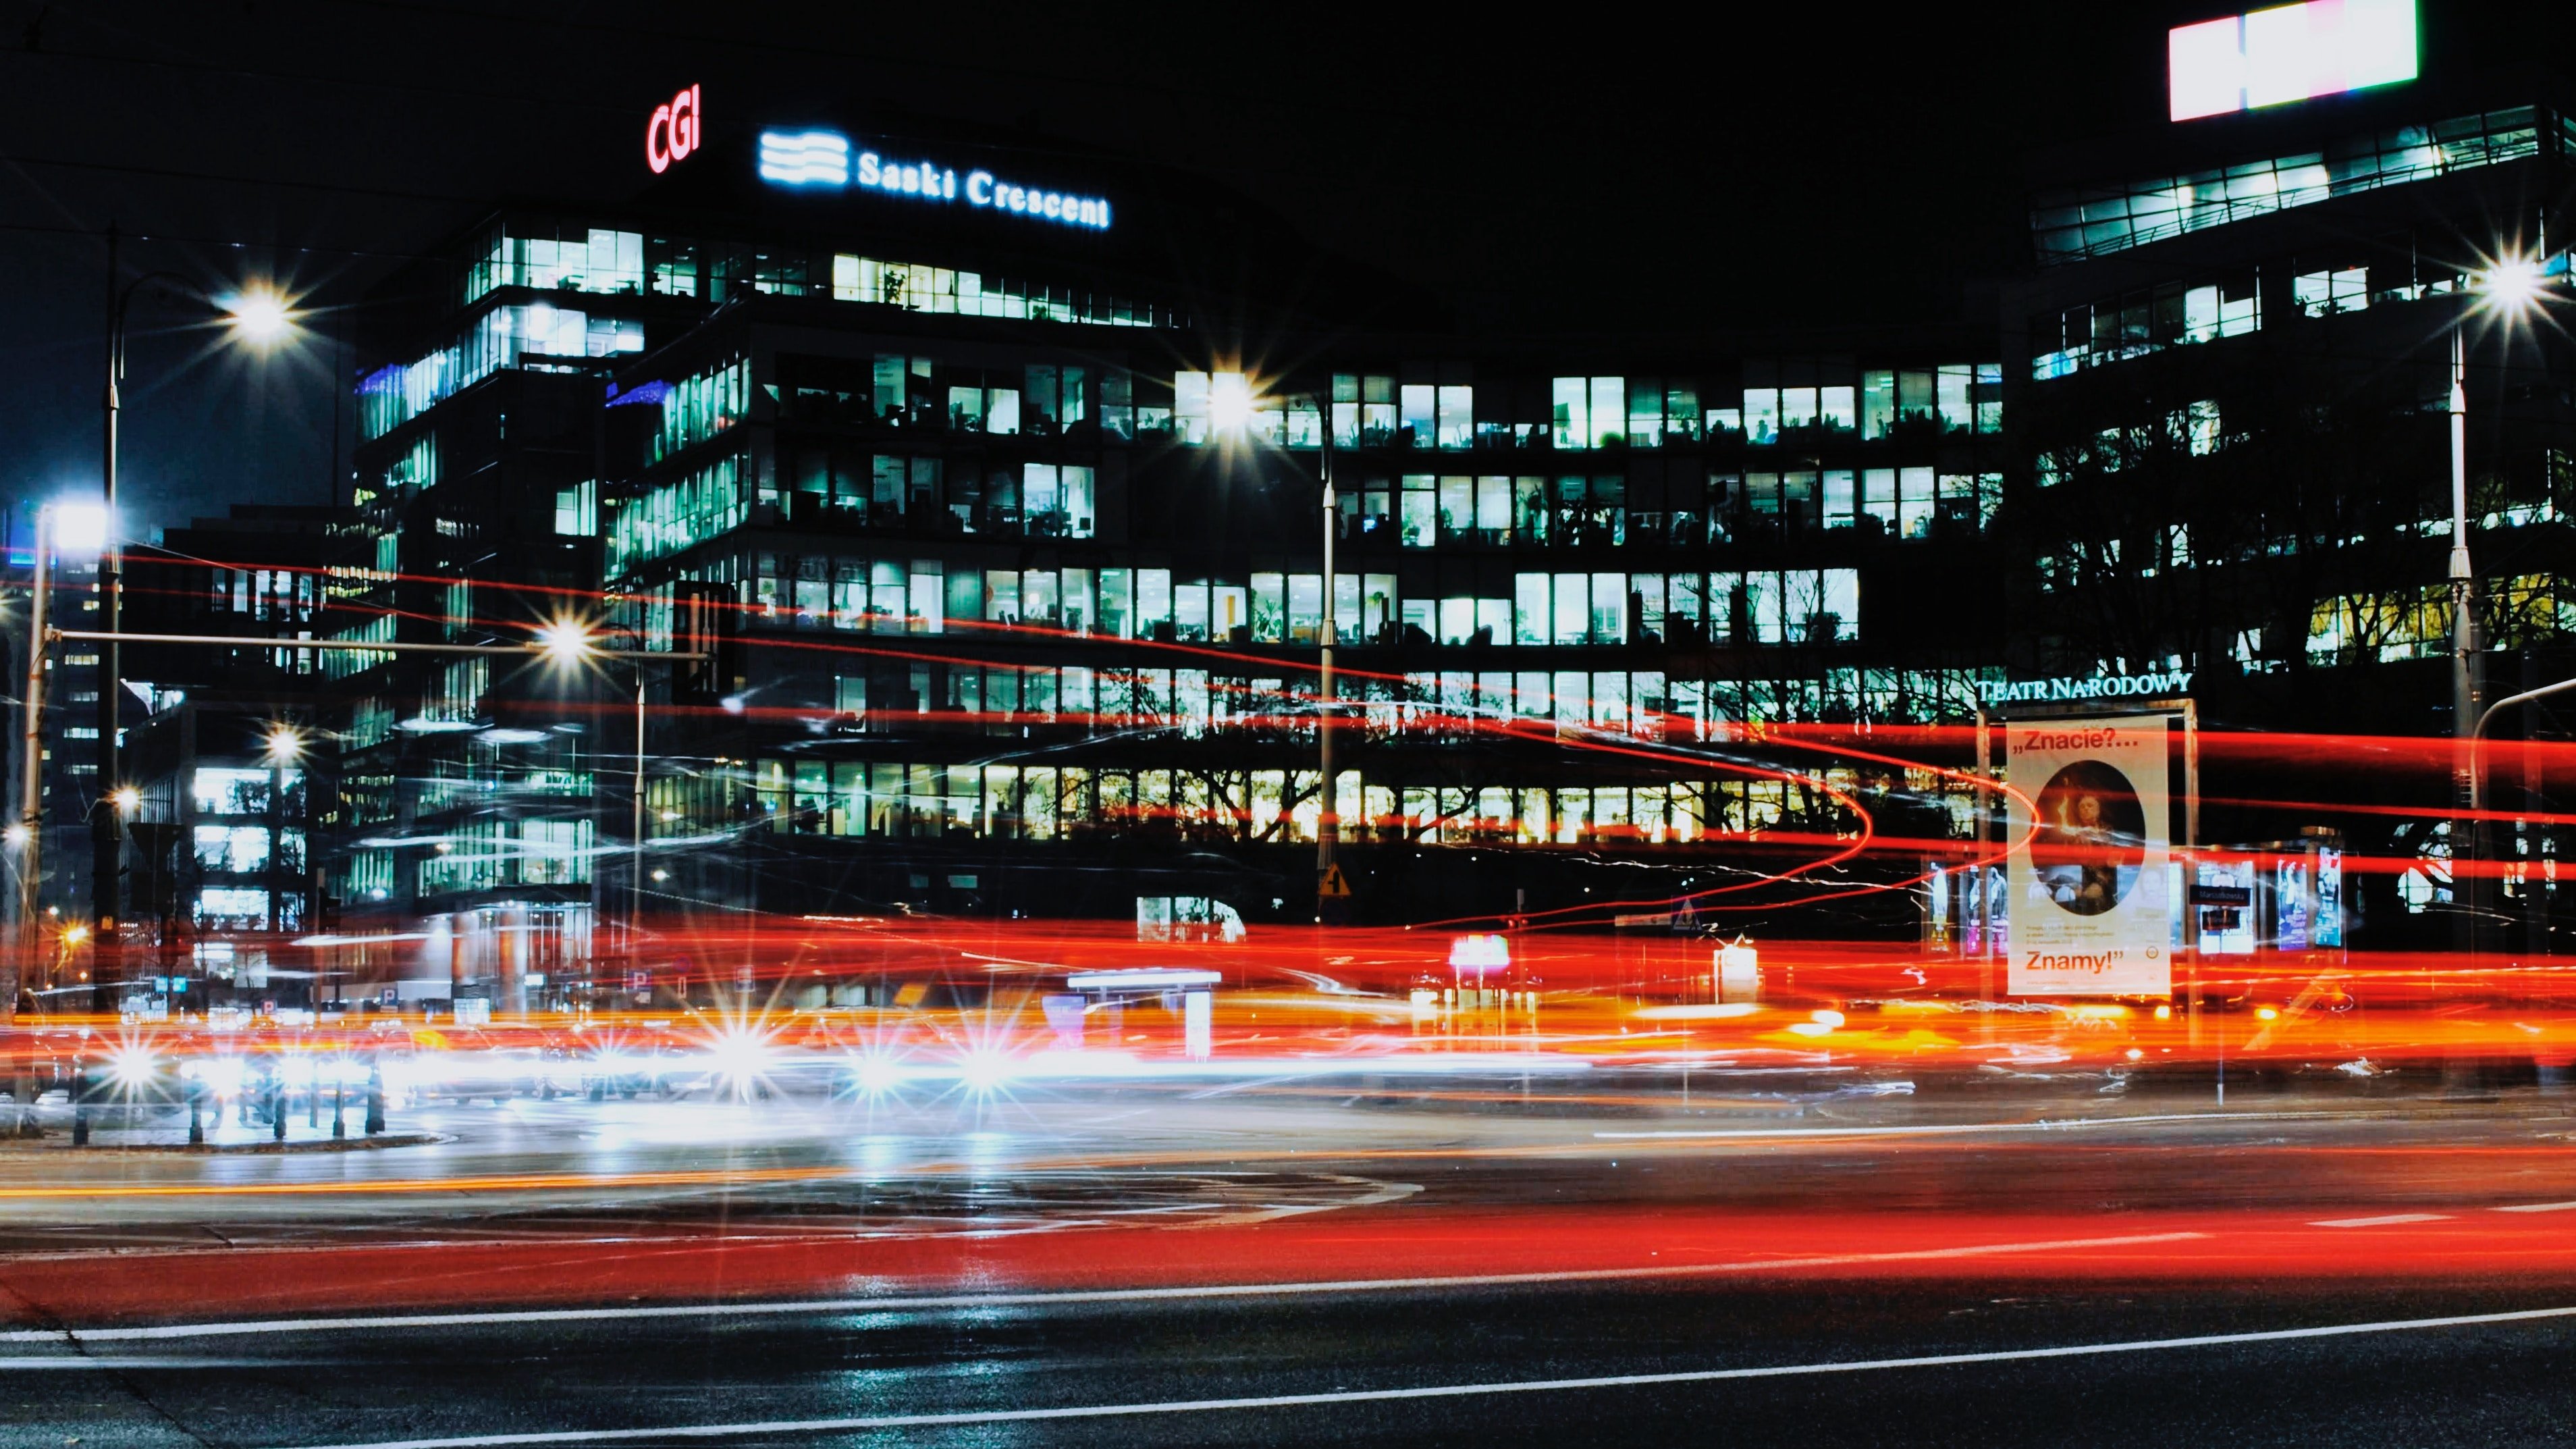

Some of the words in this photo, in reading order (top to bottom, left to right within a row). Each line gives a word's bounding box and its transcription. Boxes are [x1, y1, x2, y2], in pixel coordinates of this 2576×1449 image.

[647, 84, 699, 174] CGI
[858, 151, 956, 201] Saski
[965, 171, 1110, 230] Crescent
[1975, 681, 2048, 702] TEATR
[2049, 673, 2193, 700] NARODOWY
[384, 989, 396, 1004] P
